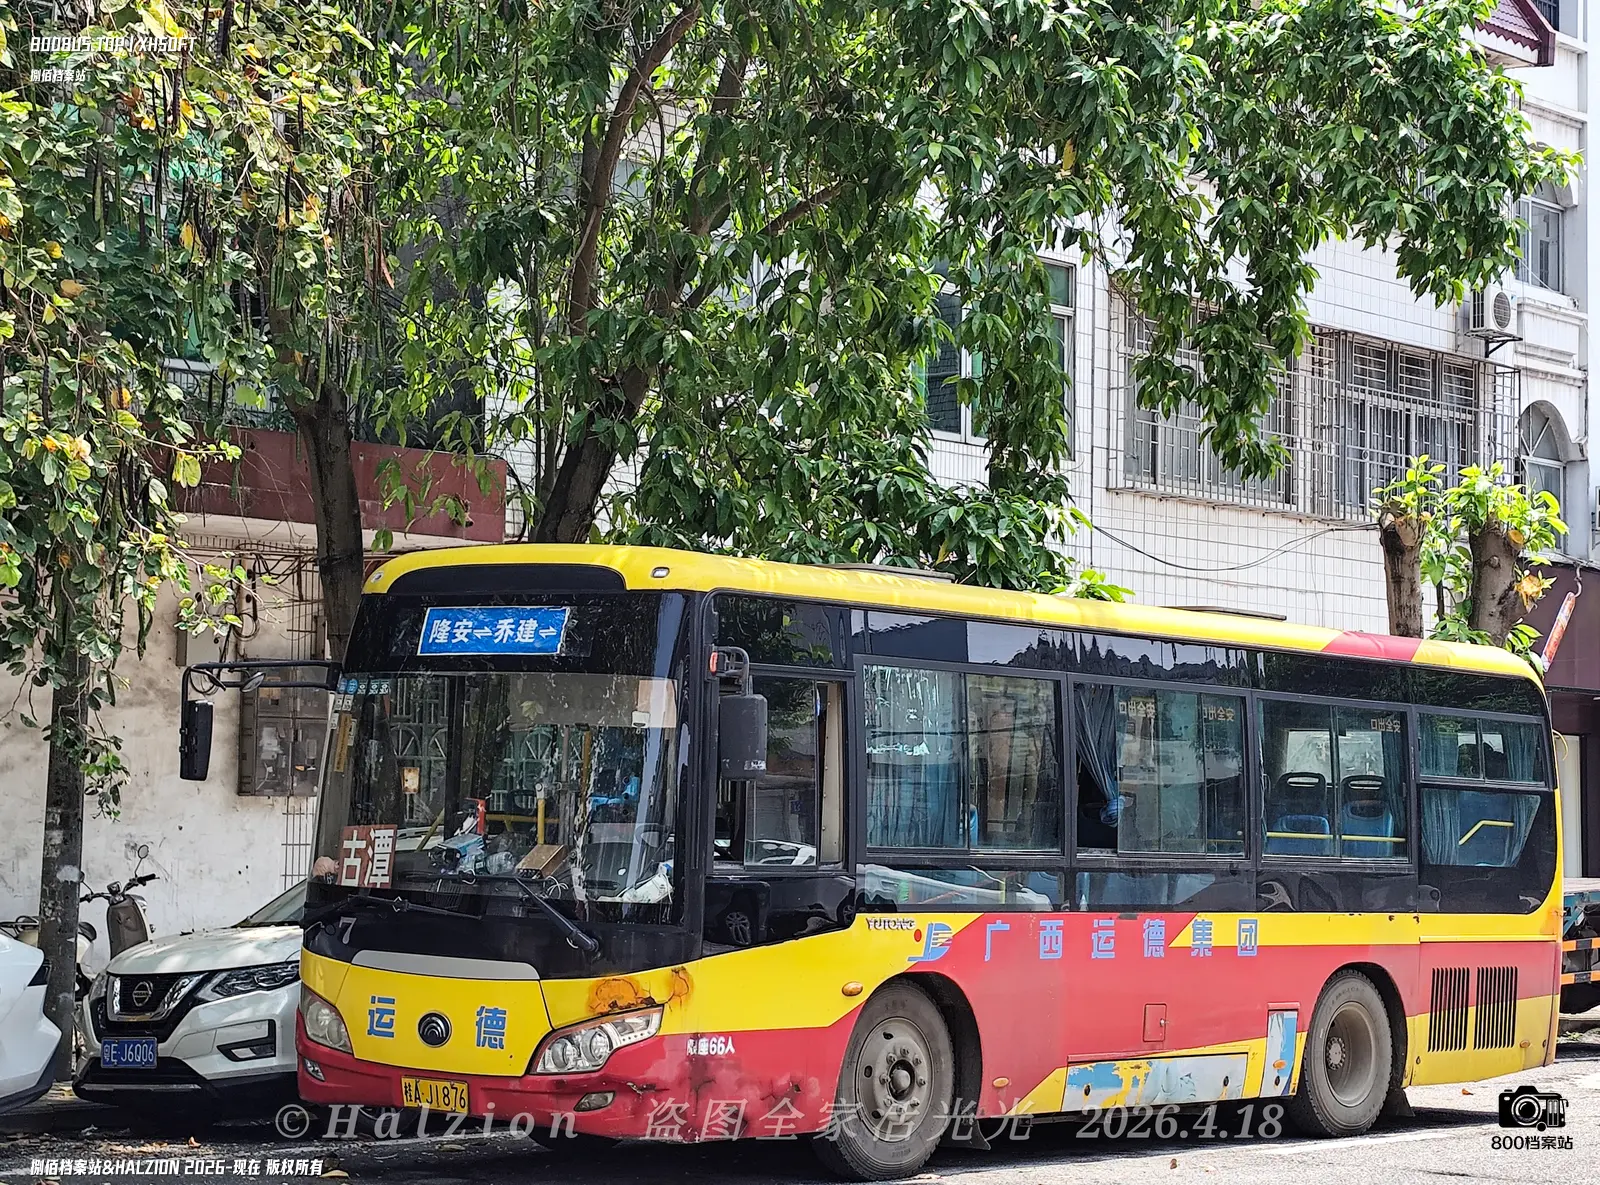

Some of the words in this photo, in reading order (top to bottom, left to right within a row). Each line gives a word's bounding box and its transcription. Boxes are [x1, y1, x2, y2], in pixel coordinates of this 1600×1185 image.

[428, 618, 473, 643] 隆安
[493, 618, 538, 643] 乔建
[341, 828, 394, 888] 古潭
[339, 916, 357, 944] 7
[866, 917, 916, 930] YUTONG
[984, 918, 1259, 962] 广西运德集团
